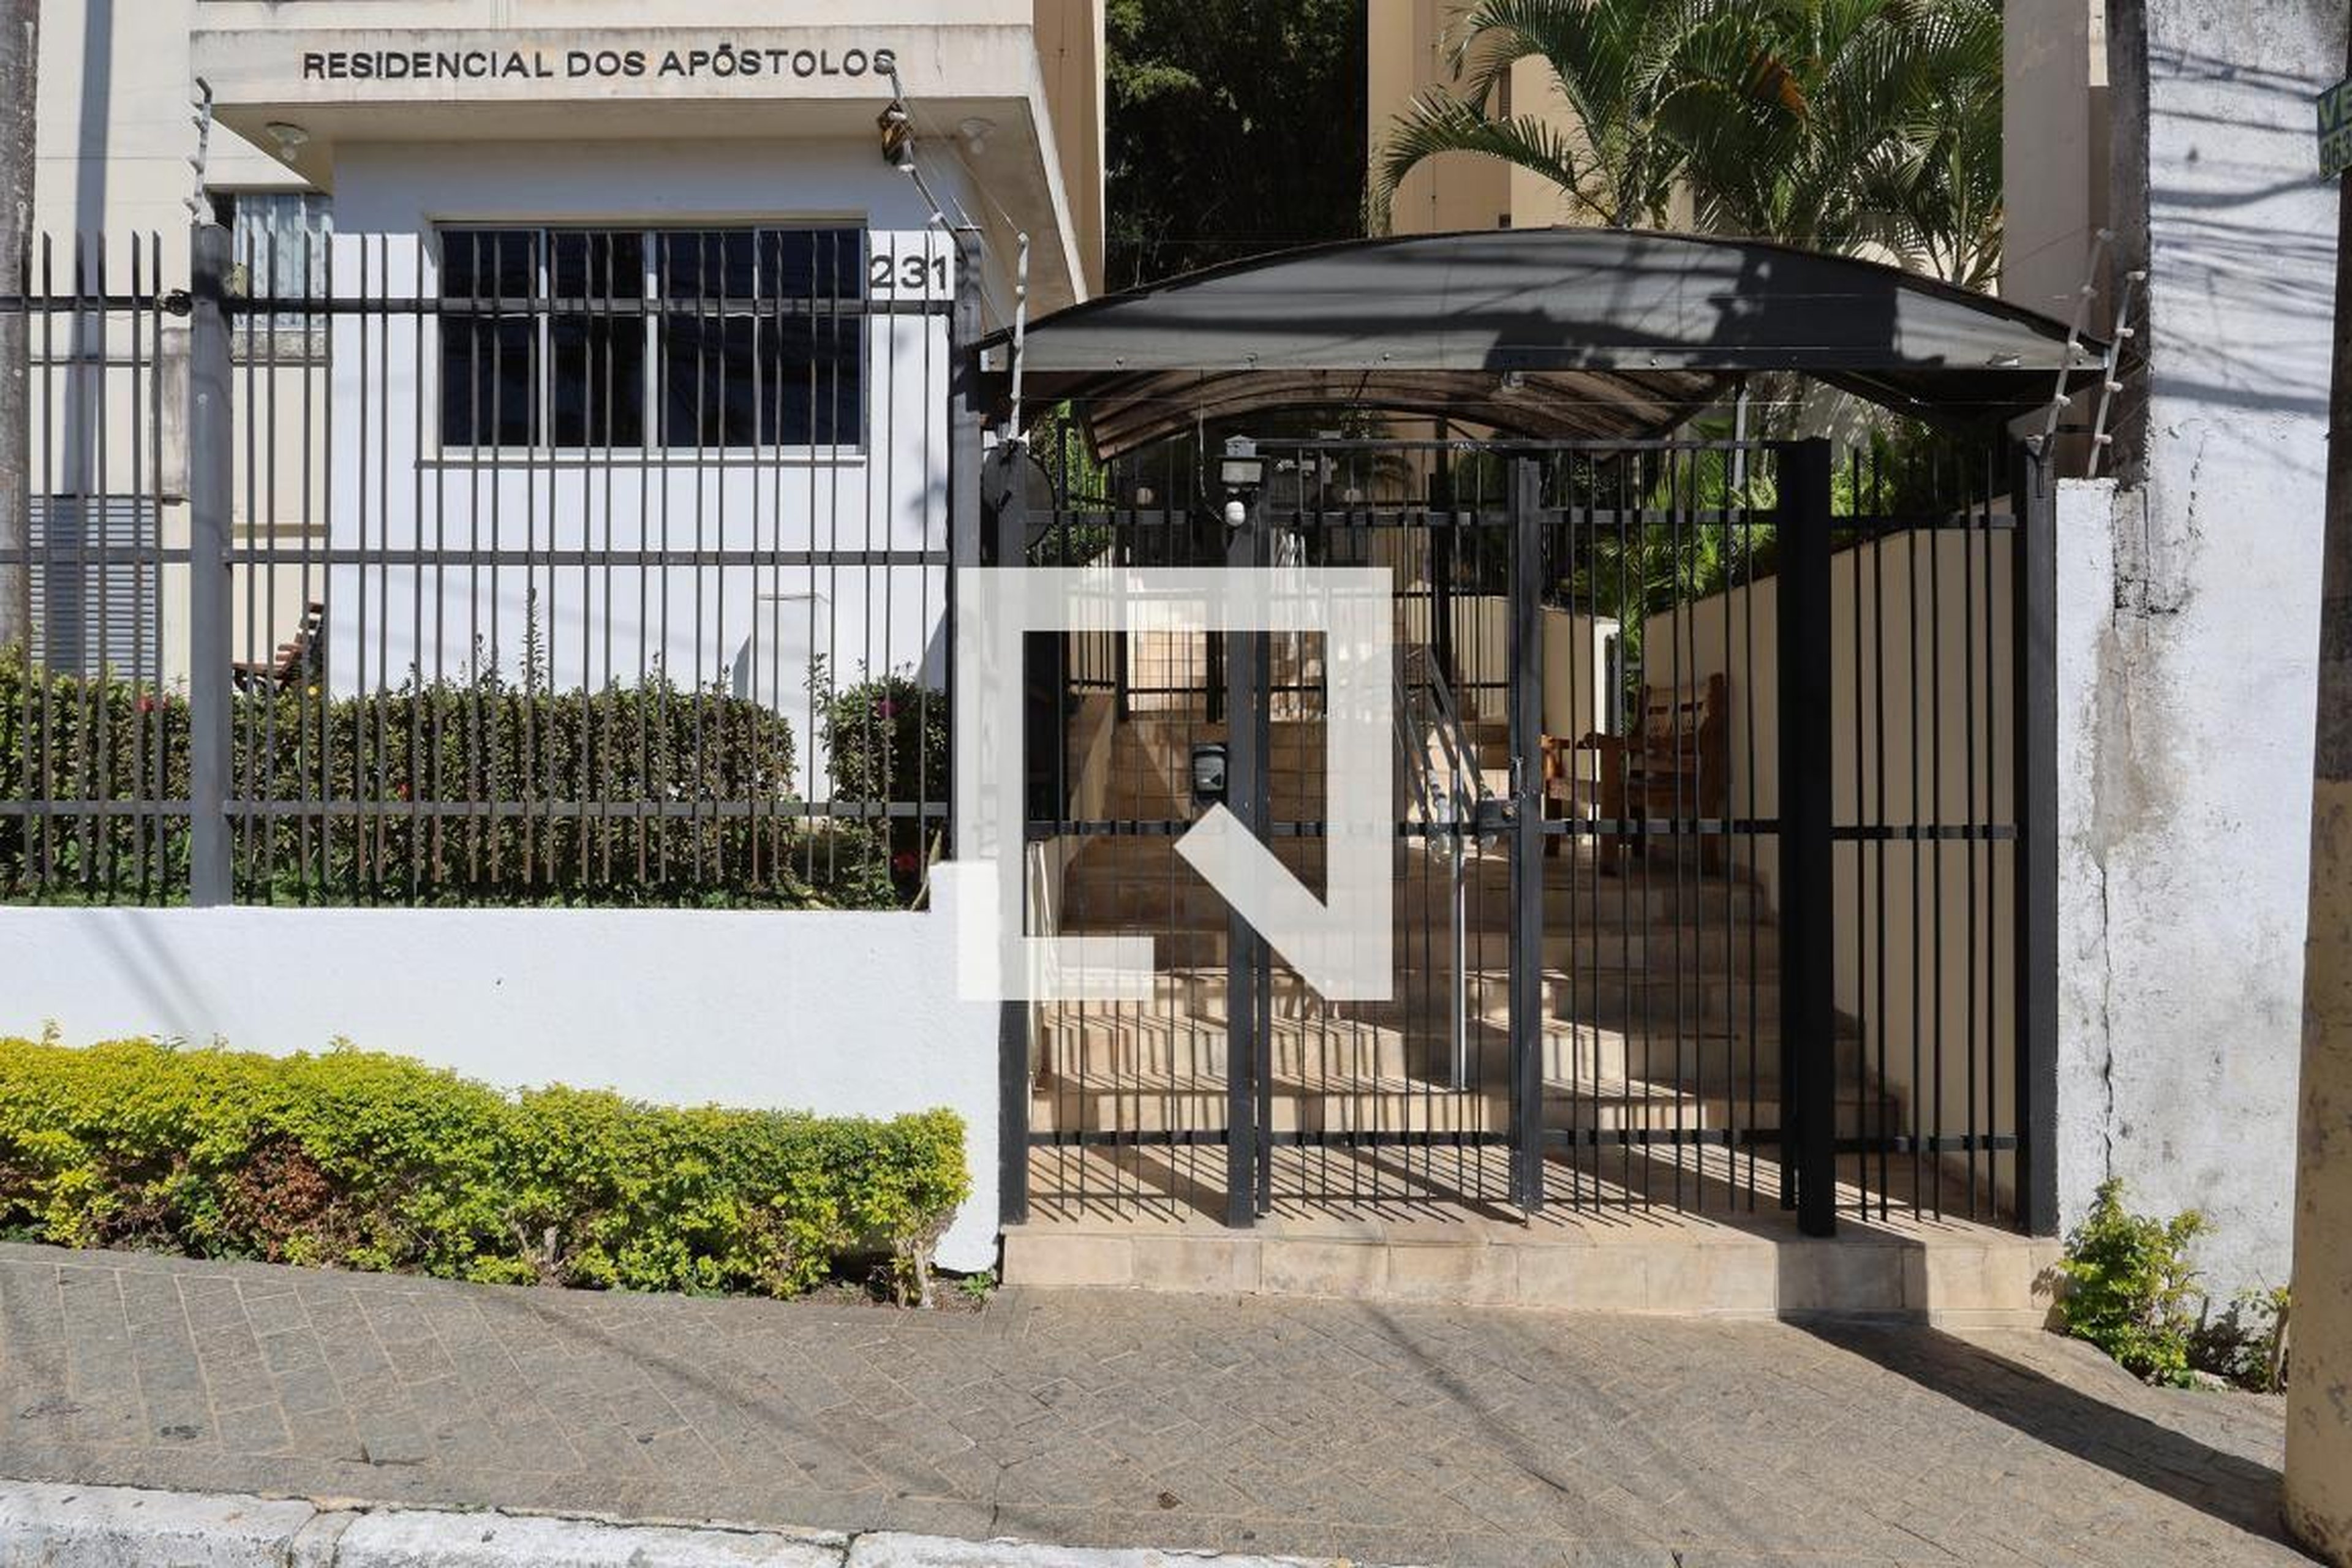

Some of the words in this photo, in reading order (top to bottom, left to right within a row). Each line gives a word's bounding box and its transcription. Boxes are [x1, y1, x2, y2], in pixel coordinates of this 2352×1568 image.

[303, 51, 553, 78] RESIDENCIAL
[567, 50, 646, 77] DOS
[657, 43, 896, 77] APÓSTOLOS
[869, 255, 946, 290] 231
